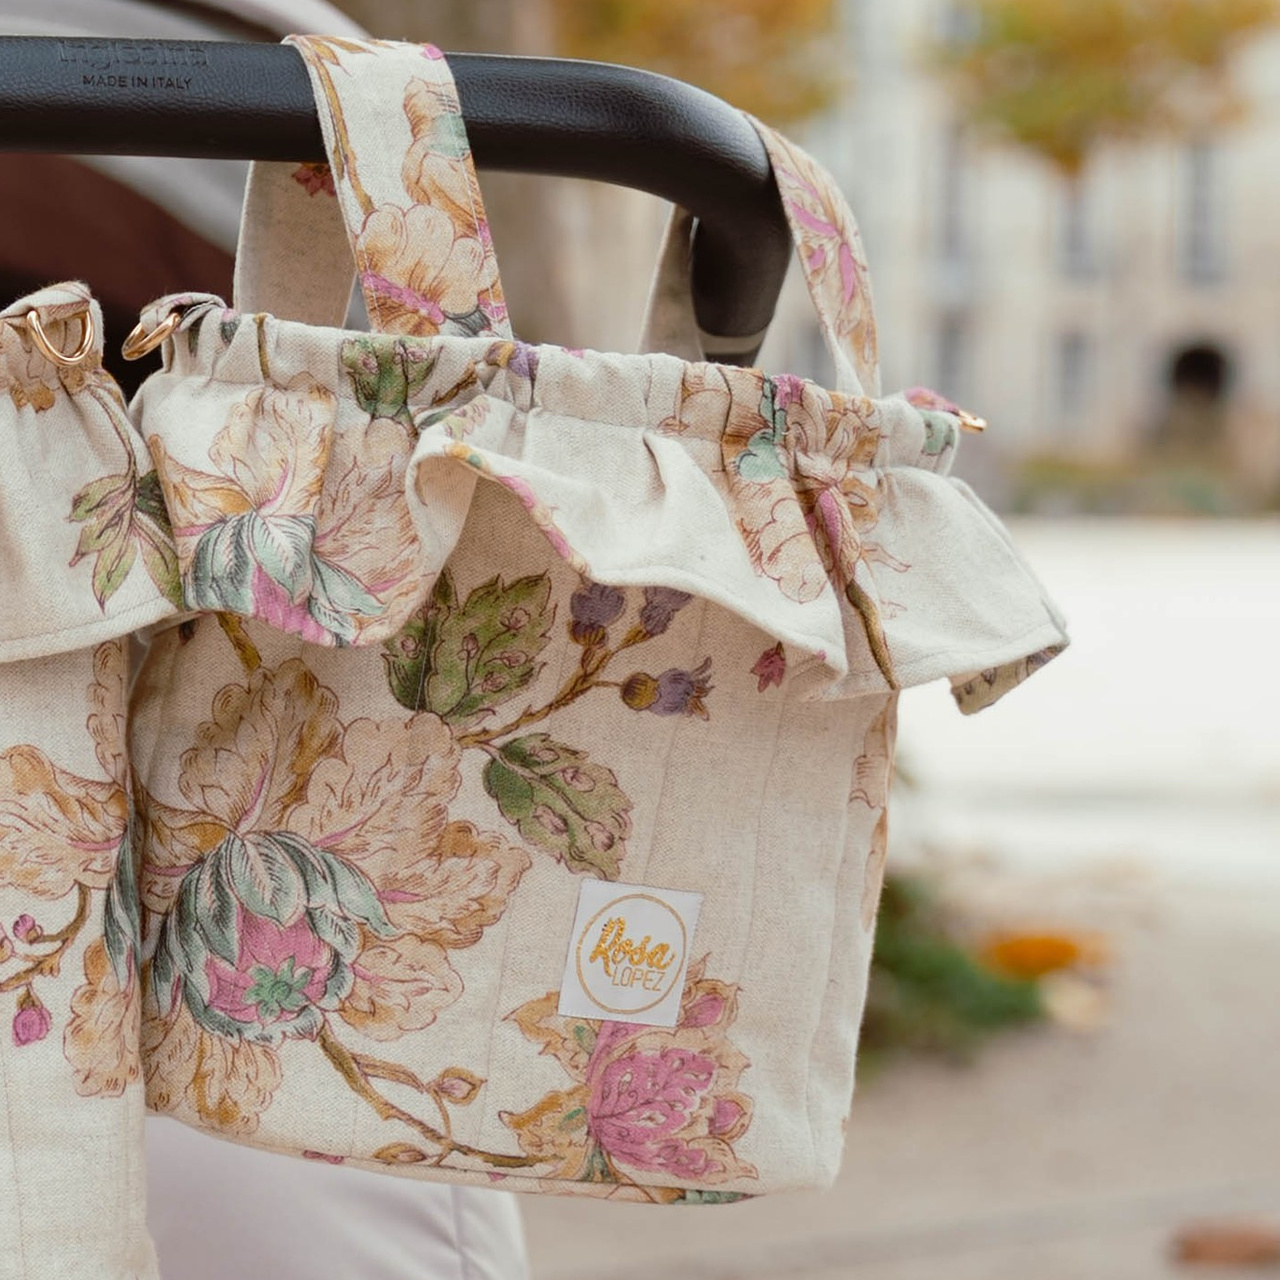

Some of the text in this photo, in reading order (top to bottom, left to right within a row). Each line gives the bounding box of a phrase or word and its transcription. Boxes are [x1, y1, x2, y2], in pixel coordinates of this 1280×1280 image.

[82, 75, 193, 90] MADE IN ITALY
[589, 917, 677, 977] Rosa
[611, 966, 666, 992] LOPEZ
